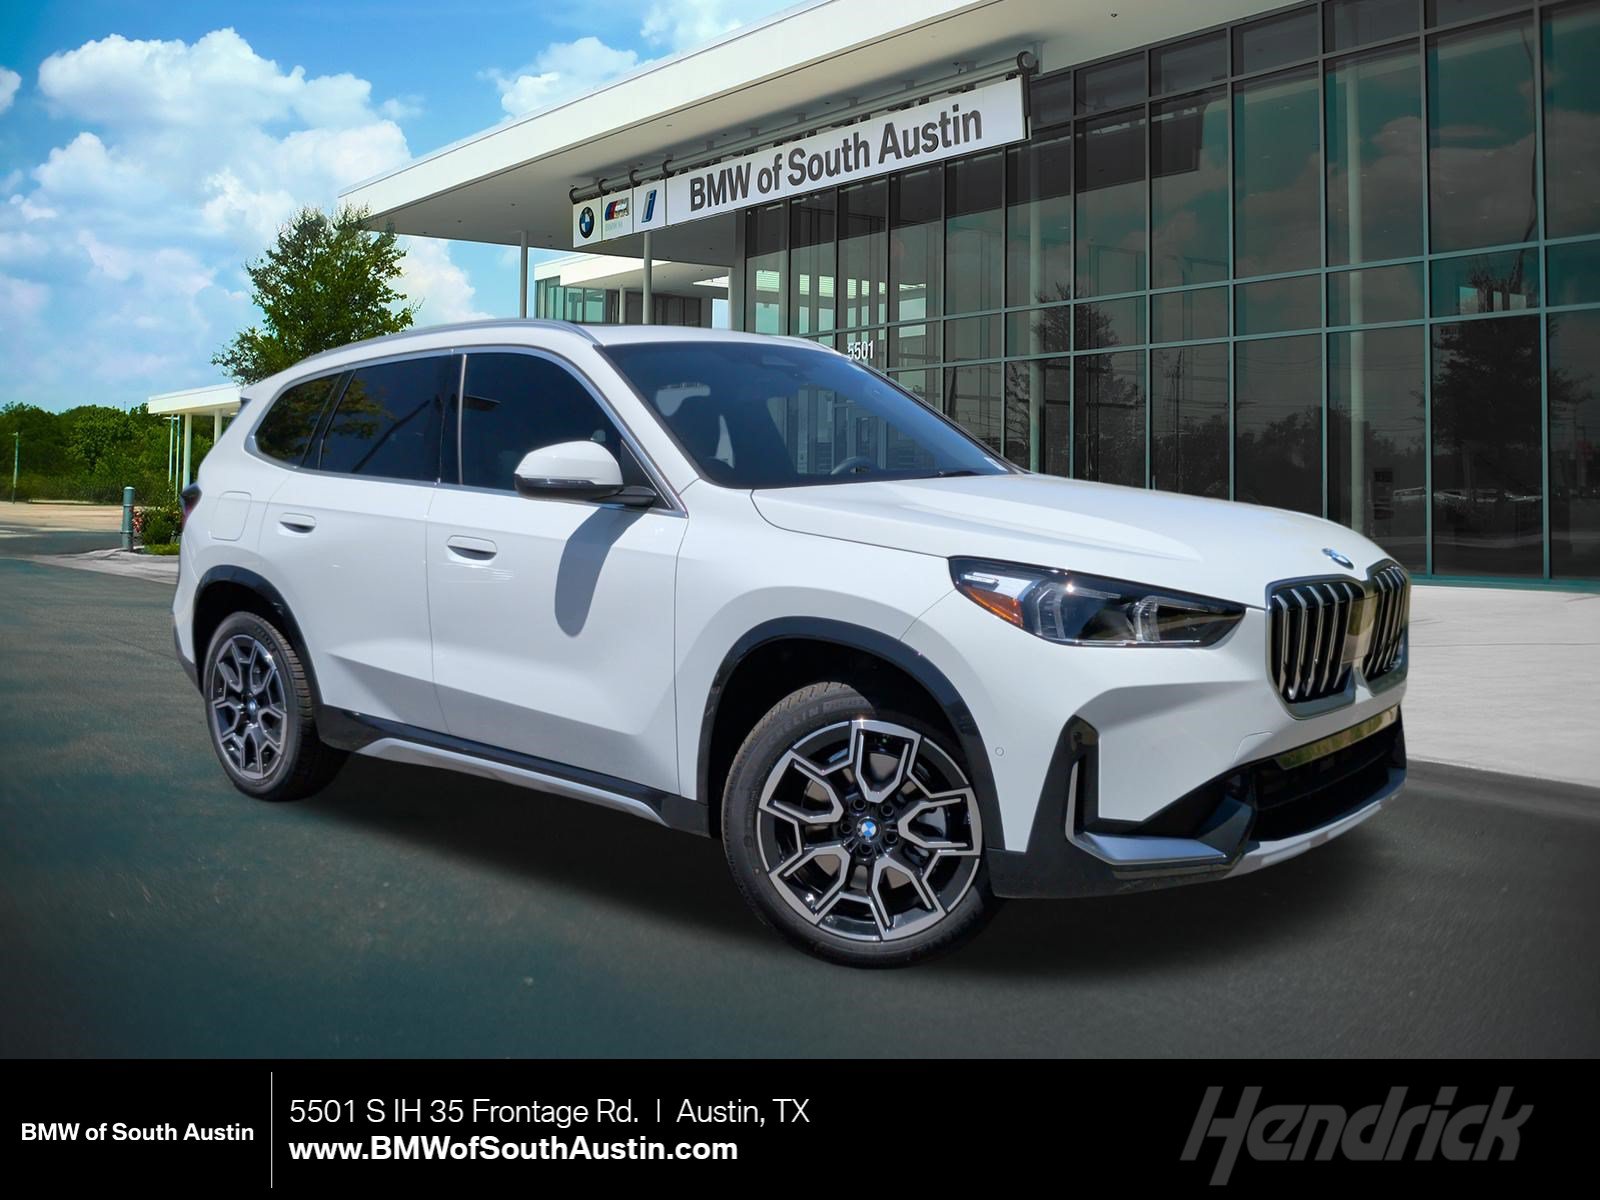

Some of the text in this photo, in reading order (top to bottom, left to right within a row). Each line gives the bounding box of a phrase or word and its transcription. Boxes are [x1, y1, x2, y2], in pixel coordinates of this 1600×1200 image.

[689, 162, 752, 211] BMW
[757, 153, 782, 194] of
[787, 132, 871, 186] South
[878, 103, 983, 164] Austin
[847, 340, 874, 360] 5501
